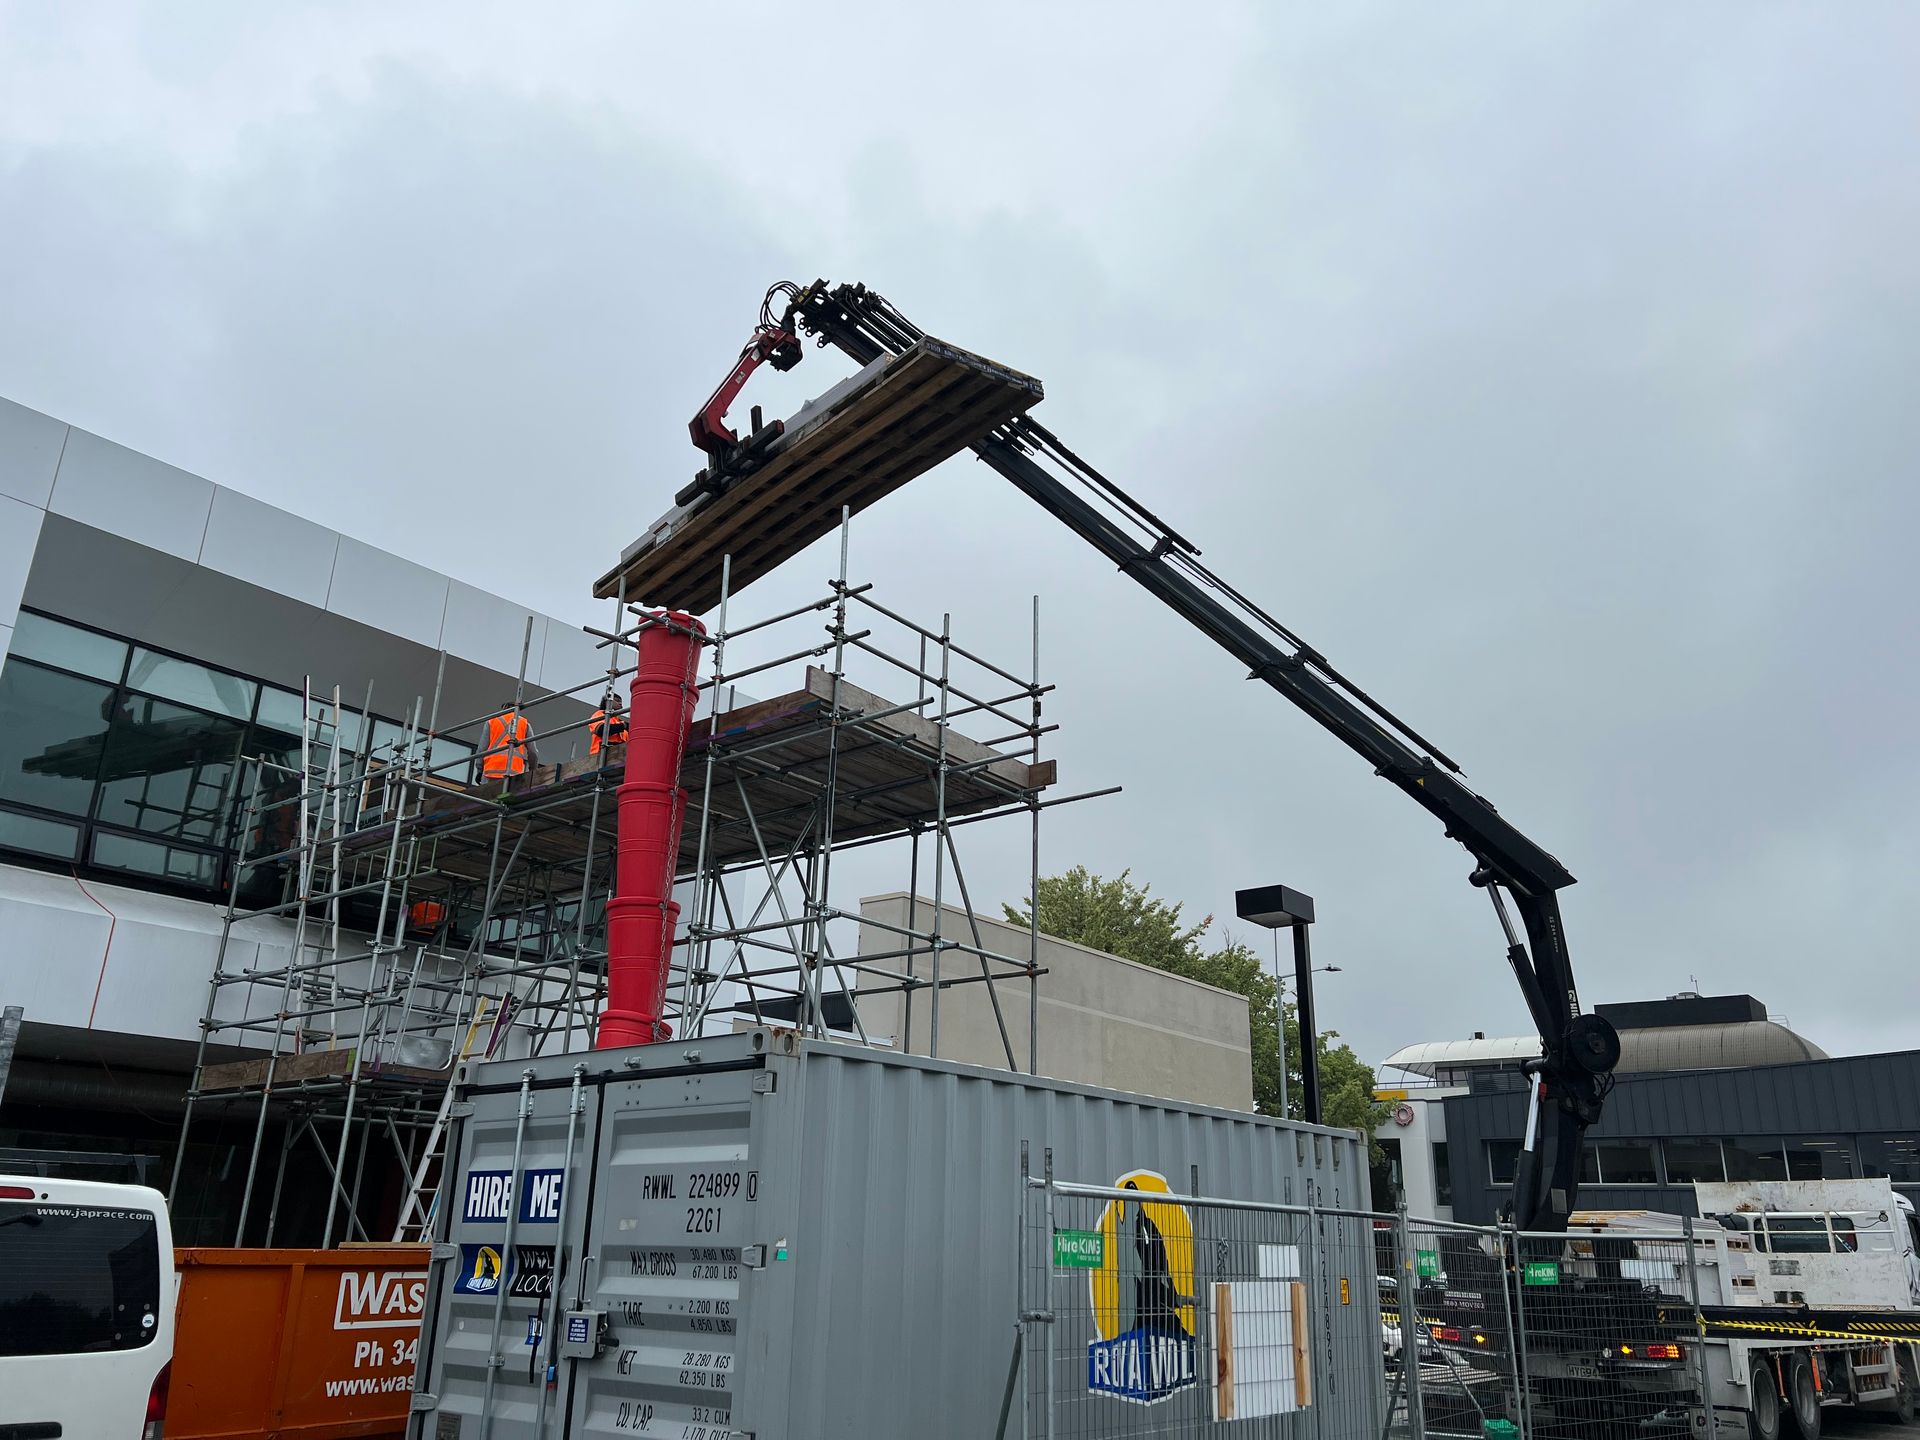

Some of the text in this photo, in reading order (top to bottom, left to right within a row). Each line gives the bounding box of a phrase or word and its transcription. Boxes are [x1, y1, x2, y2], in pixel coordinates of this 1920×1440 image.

[467, 1174, 562, 1218] HIRE ME
[642, 1172, 758, 1200] RWWL 224899 0
[36, 1207, 153, 1221] www.japrace.com
[686, 1207, 721, 1233] 22G1
[521, 1250, 558, 1269] WOL
[690, 1248, 717, 1261] 30.480
[720, 1248, 737, 1261] KGS
[515, 1274, 556, 1293] LOCK
[692, 1265, 738, 1280] 67.200 LBS
[340, 1272, 427, 1315] WAS
[622, 1299, 731, 1326] TARE 2.200 KGS
[690, 1318, 732, 1333] 4.850 LBS
[354, 1338, 418, 1368] Ph 34
[617, 1349, 731, 1375] NET 28.280 KGS
[325, 1375, 415, 1398] www.was
[680, 1370, 726, 1388] 62.350 LBS
[632, 1403, 653, 1431] CAP.
[692, 1406, 710, 1424] 33.2
